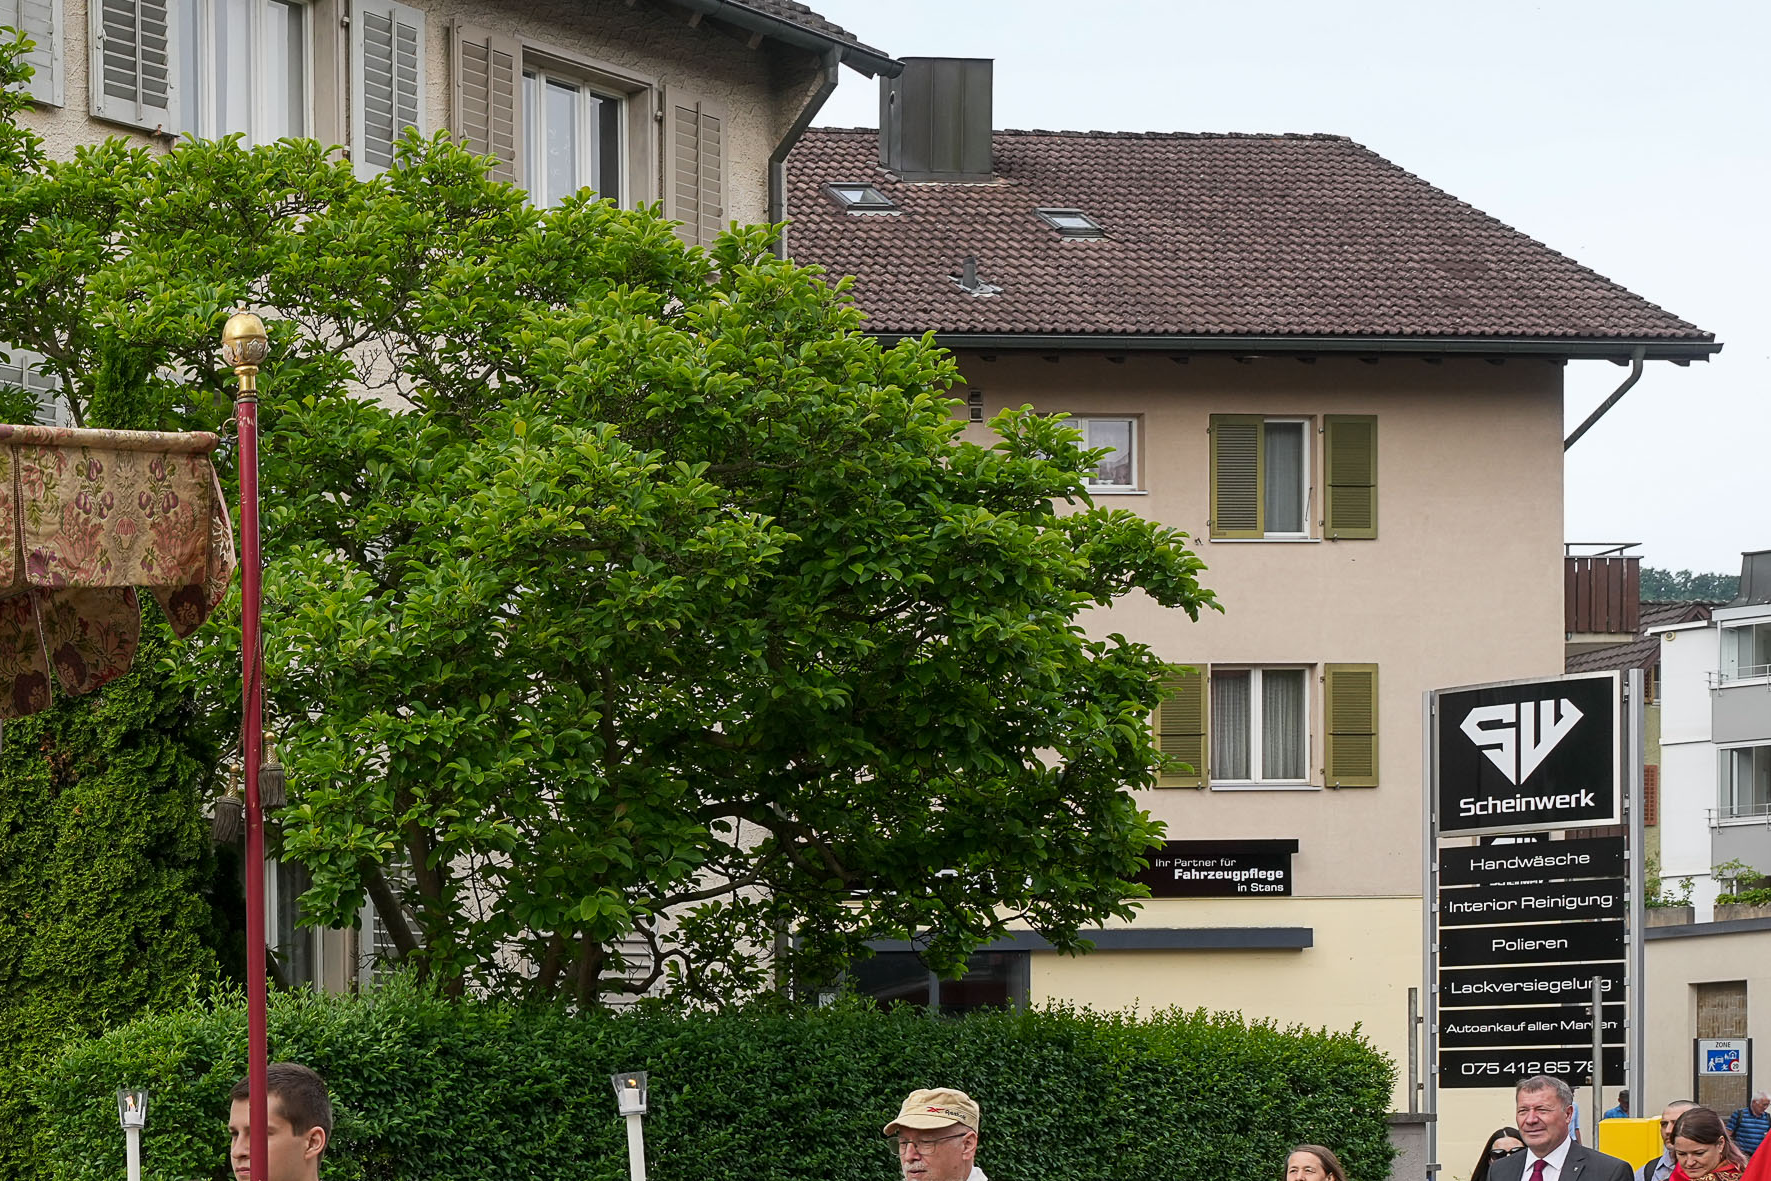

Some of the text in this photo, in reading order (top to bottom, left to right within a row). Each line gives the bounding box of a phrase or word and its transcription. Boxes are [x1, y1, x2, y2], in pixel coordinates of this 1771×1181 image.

[1459, 789, 1595, 817] Scheinwerk
[1155, 858, 1237, 867] Ihr Partner für
[1470, 852, 1591, 871] Handwäsche
[1174, 868, 1284, 881] Fahrzeugpflege
[1237, 882, 1284, 892] in Stans
[1449, 894, 1613, 913] Interior Reinigung
[1492, 938, 1568, 951] Polieren
[1446, 1020, 1616, 1034] Autoankauf aller Maren
[1461, 1062, 1500, 1075] 075
[1503, 1062, 1541, 1074] 412
[1544, 1061, 1571, 1073] 65
